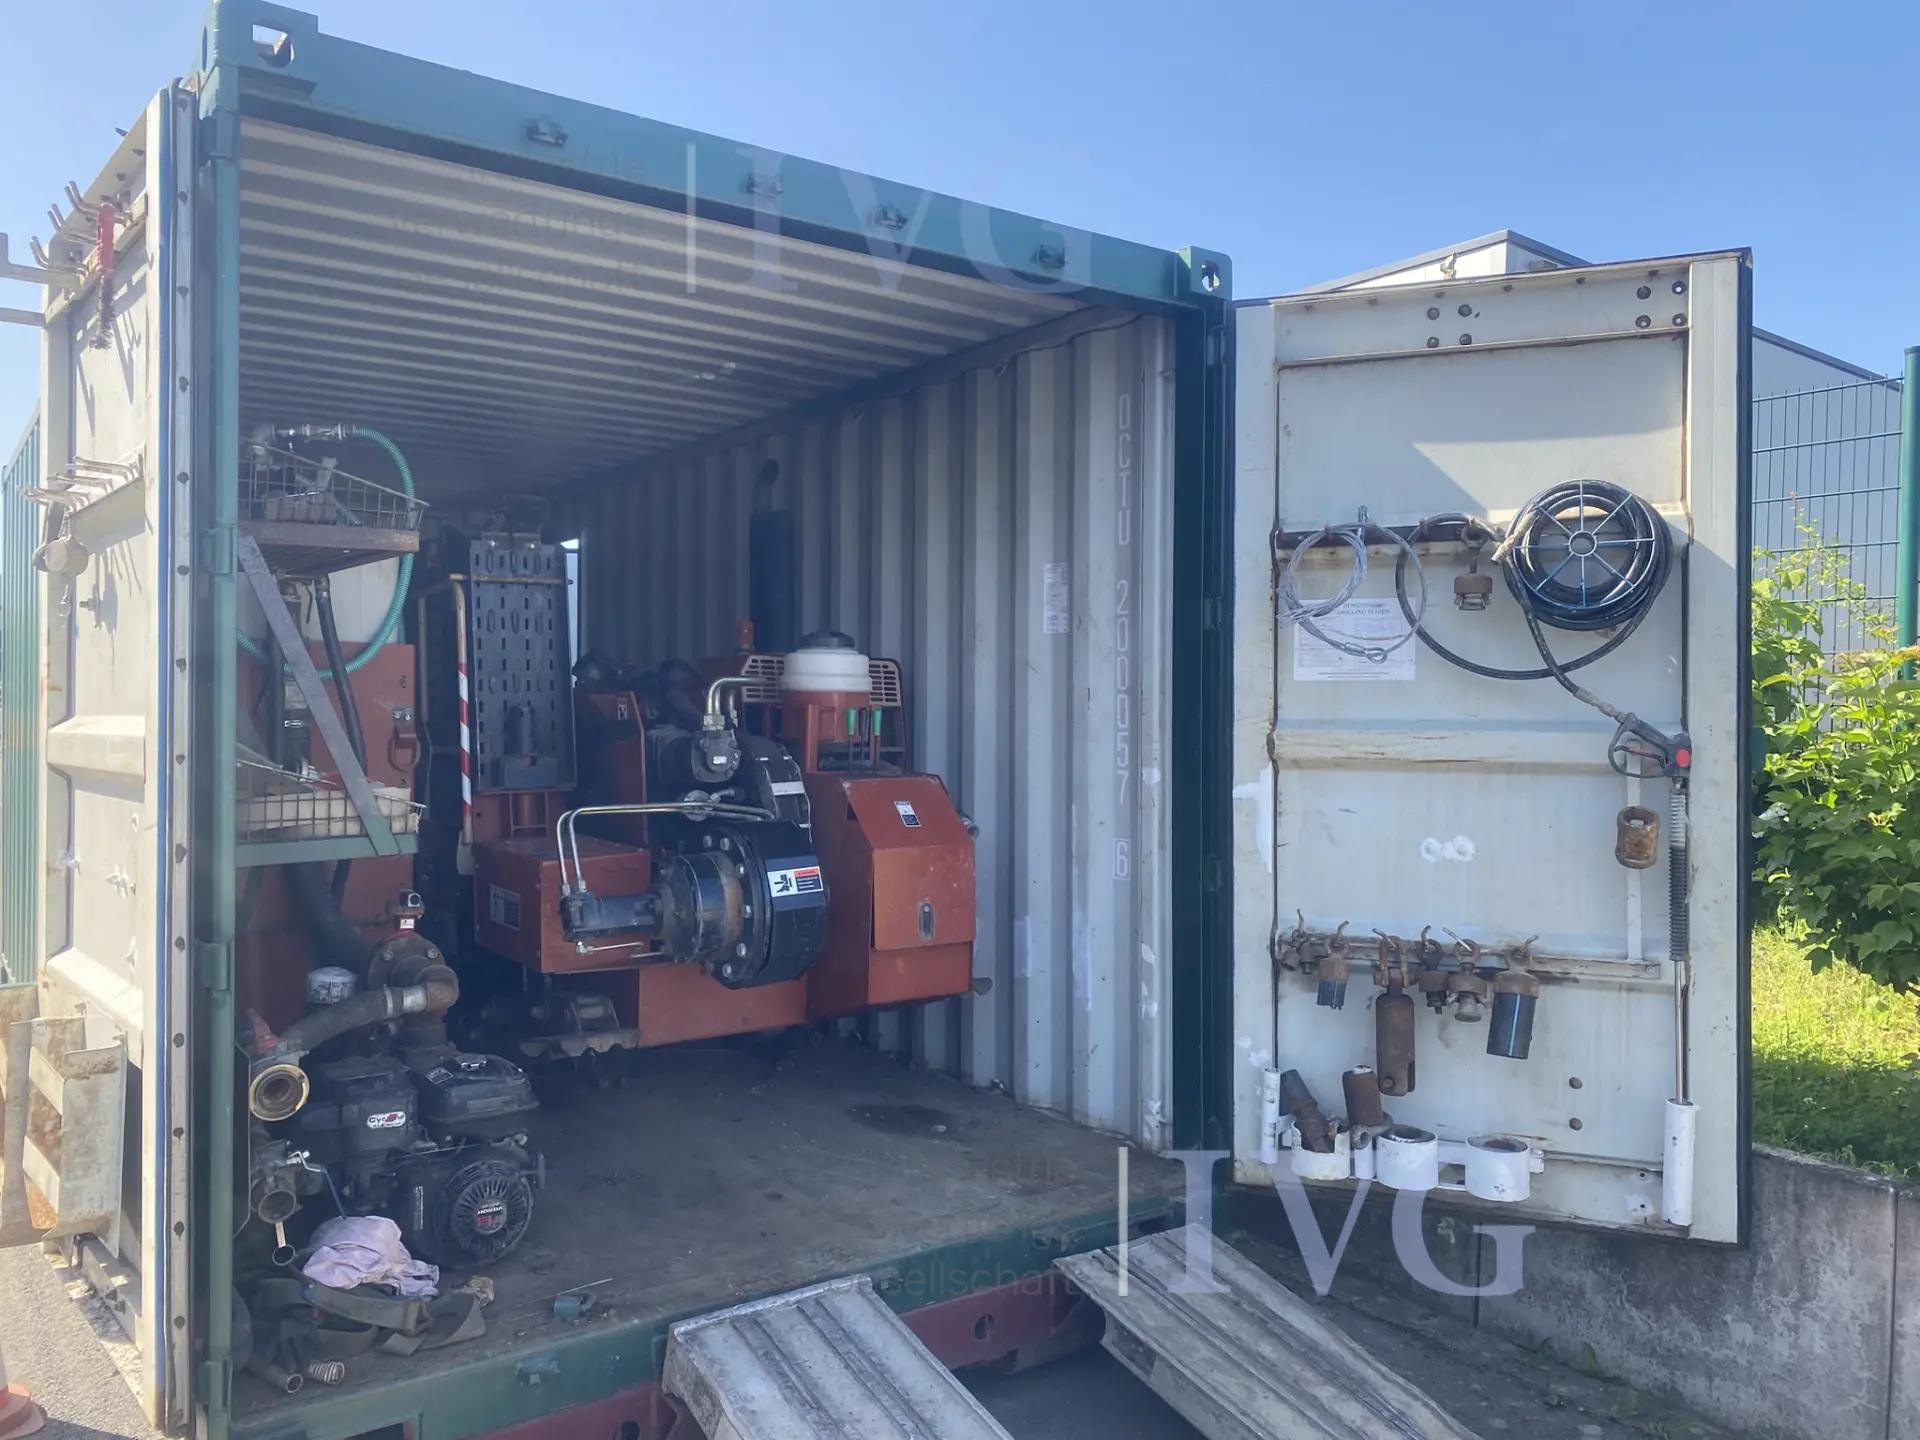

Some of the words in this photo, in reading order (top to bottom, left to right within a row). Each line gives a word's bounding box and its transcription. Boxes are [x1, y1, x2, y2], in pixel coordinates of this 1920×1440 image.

[1118, 393, 1131, 546] OCTU
[1115, 579, 1130, 805] 200057
[1116, 841, 1128, 877] 6
[477, 1205, 503, 1215] HONDA
